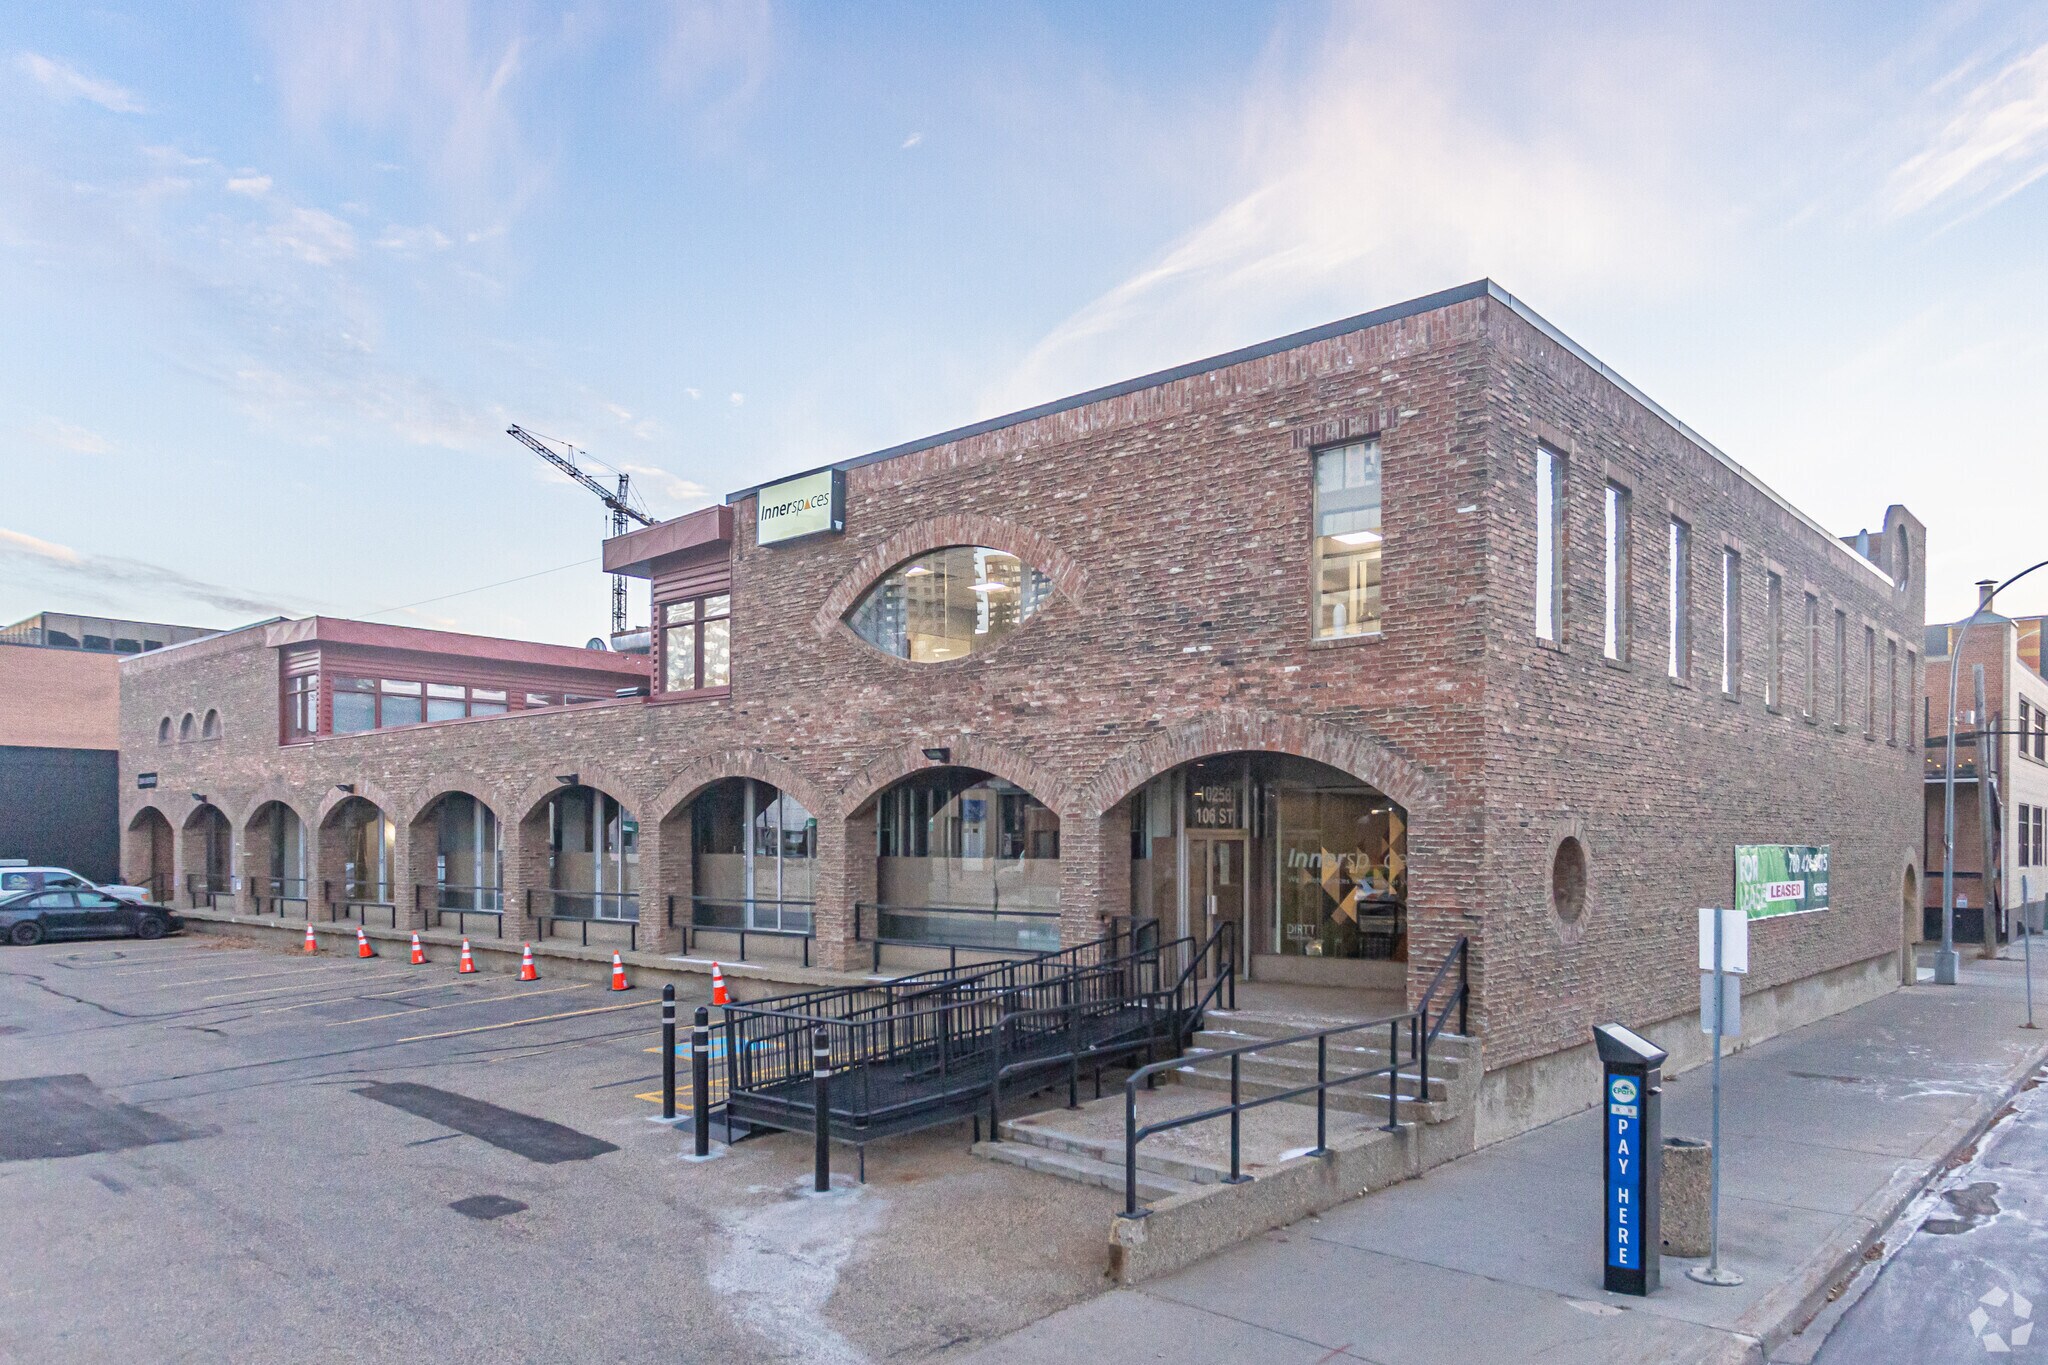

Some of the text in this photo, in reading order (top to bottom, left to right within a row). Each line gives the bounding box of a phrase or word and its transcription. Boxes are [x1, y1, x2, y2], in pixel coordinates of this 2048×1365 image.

[1200, 786, 1232, 802] 10258
[1196, 807, 1234, 824] 106 ST
[1770, 883, 1801, 899] LEASED
[1286, 923, 1316, 936] DIRTT
[1618, 1119, 1629, 1175] PAY
[1618, 1187, 1629, 1264] HERE
